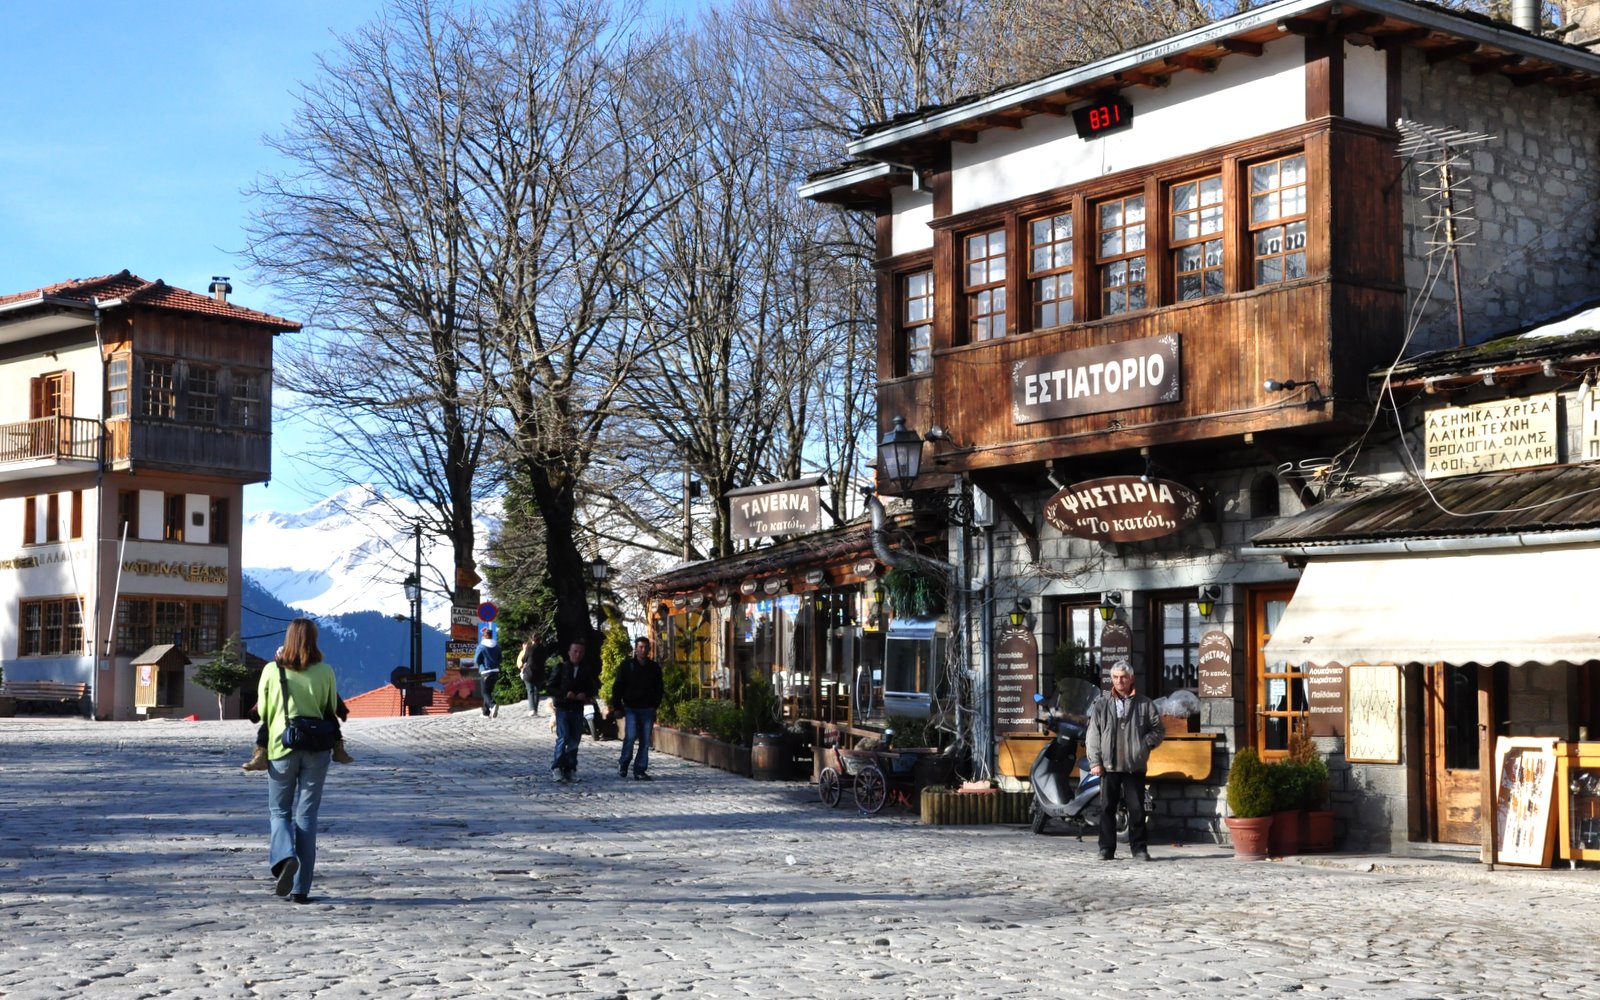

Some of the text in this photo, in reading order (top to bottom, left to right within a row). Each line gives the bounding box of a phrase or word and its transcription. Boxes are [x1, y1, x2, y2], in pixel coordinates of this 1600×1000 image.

[1024, 353, 1165, 407] ΕΣΤΙΑΤΟΡΙΟ
[1503, 401, 1551, 418] ΧΡΥΣΑ
[1481, 418, 1530, 437] ΤΕΧΝΗ
[1504, 431, 1548, 448] ΦΙΛΜΣ
[1490, 445, 1553, 466] ΤΑΛΑΡΗ
[741, 493, 810, 519] TAVERNA
[1060, 482, 1176, 514] ΨΗΣΤΑΡΙΑ
[1199, 649, 1231, 665] ΨΗΣΤΑΡΙΑ
[1309, 665, 1343, 676] Λουκάνικο
[1309, 675, 1342, 685] Χωριάτικο
